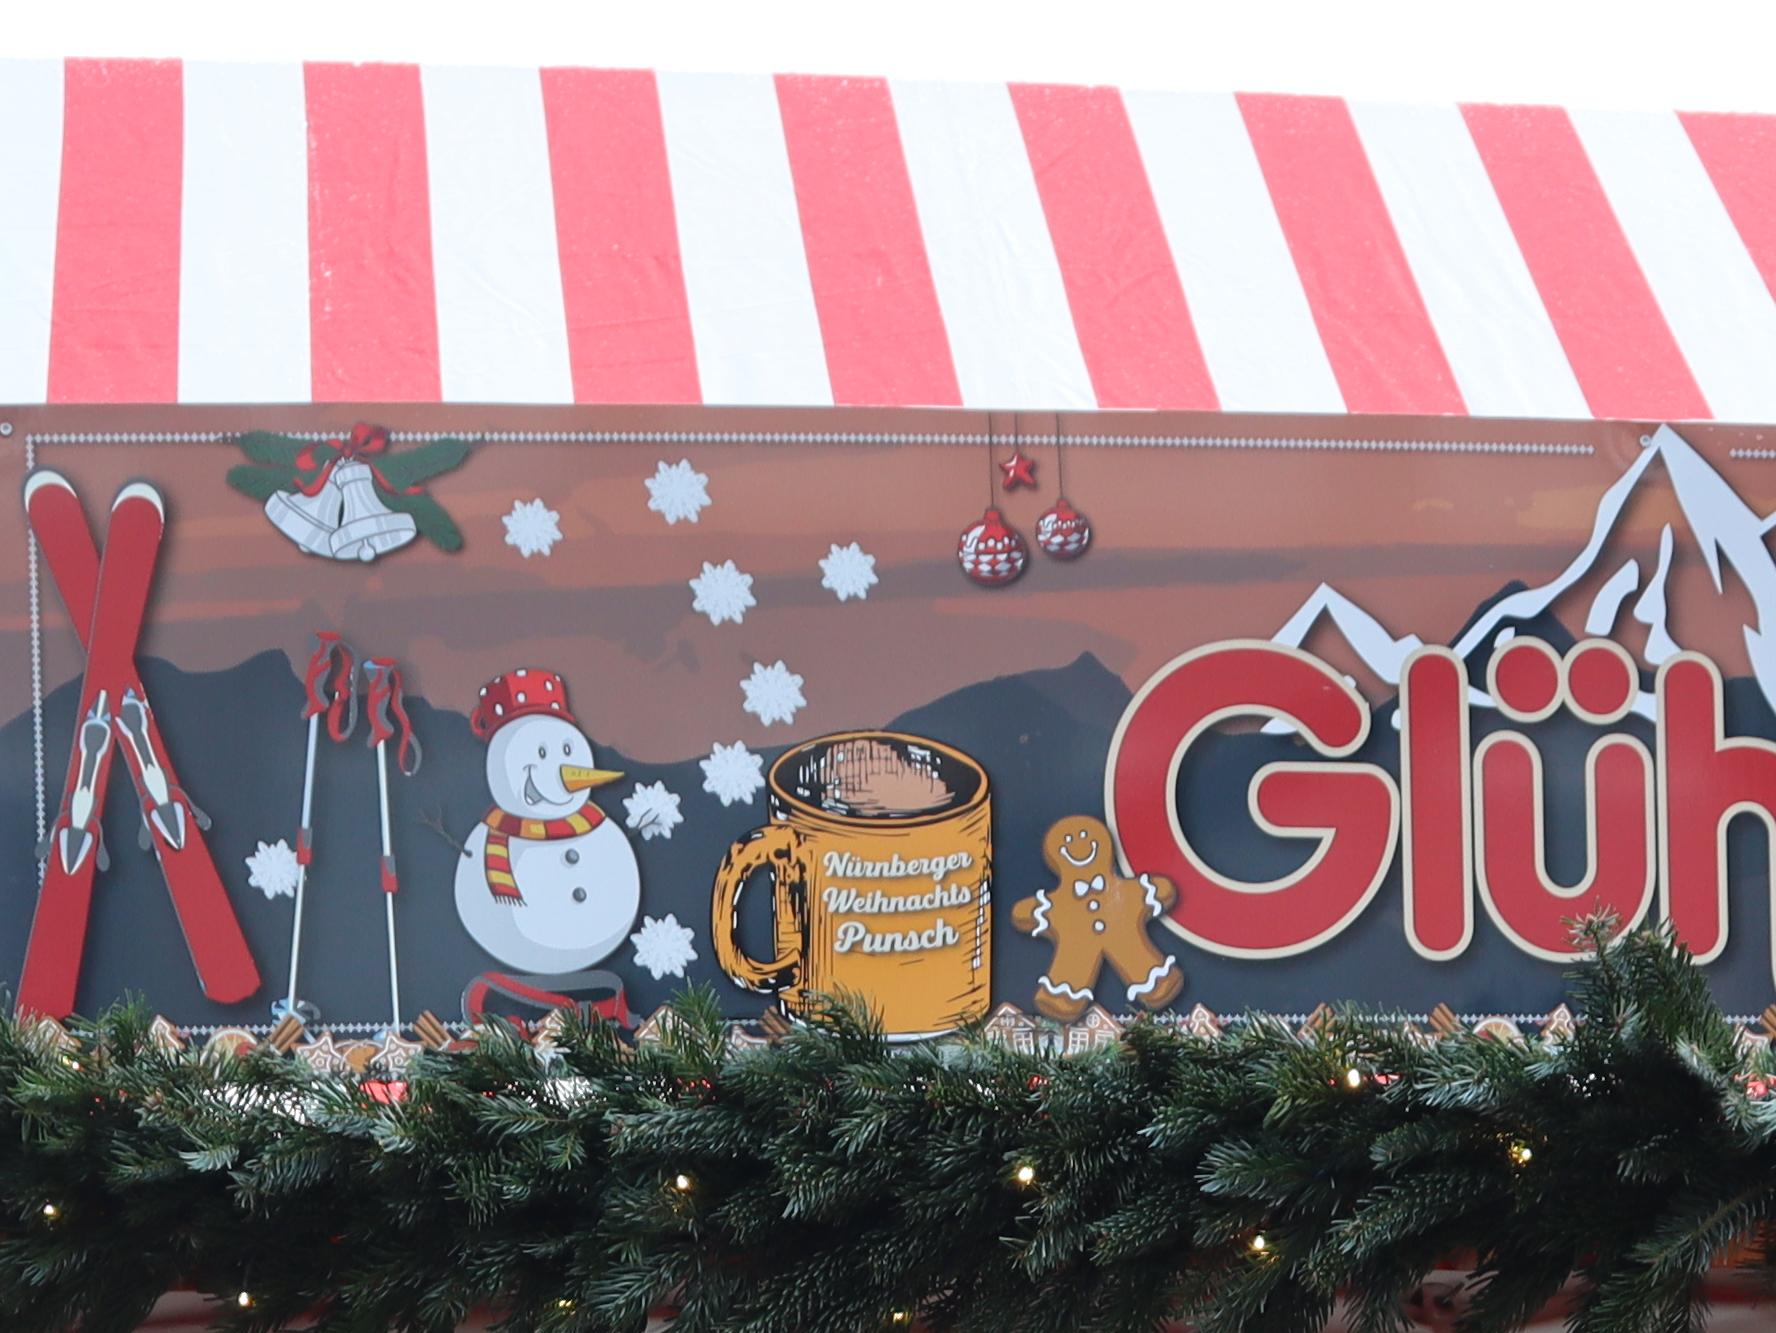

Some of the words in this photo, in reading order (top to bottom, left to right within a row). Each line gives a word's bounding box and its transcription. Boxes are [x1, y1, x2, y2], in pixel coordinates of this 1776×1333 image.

[823, 851, 972, 880] Nürnberger
[822, 883, 971, 913] Weihnachts
[833, 918, 959, 953] Punsch
